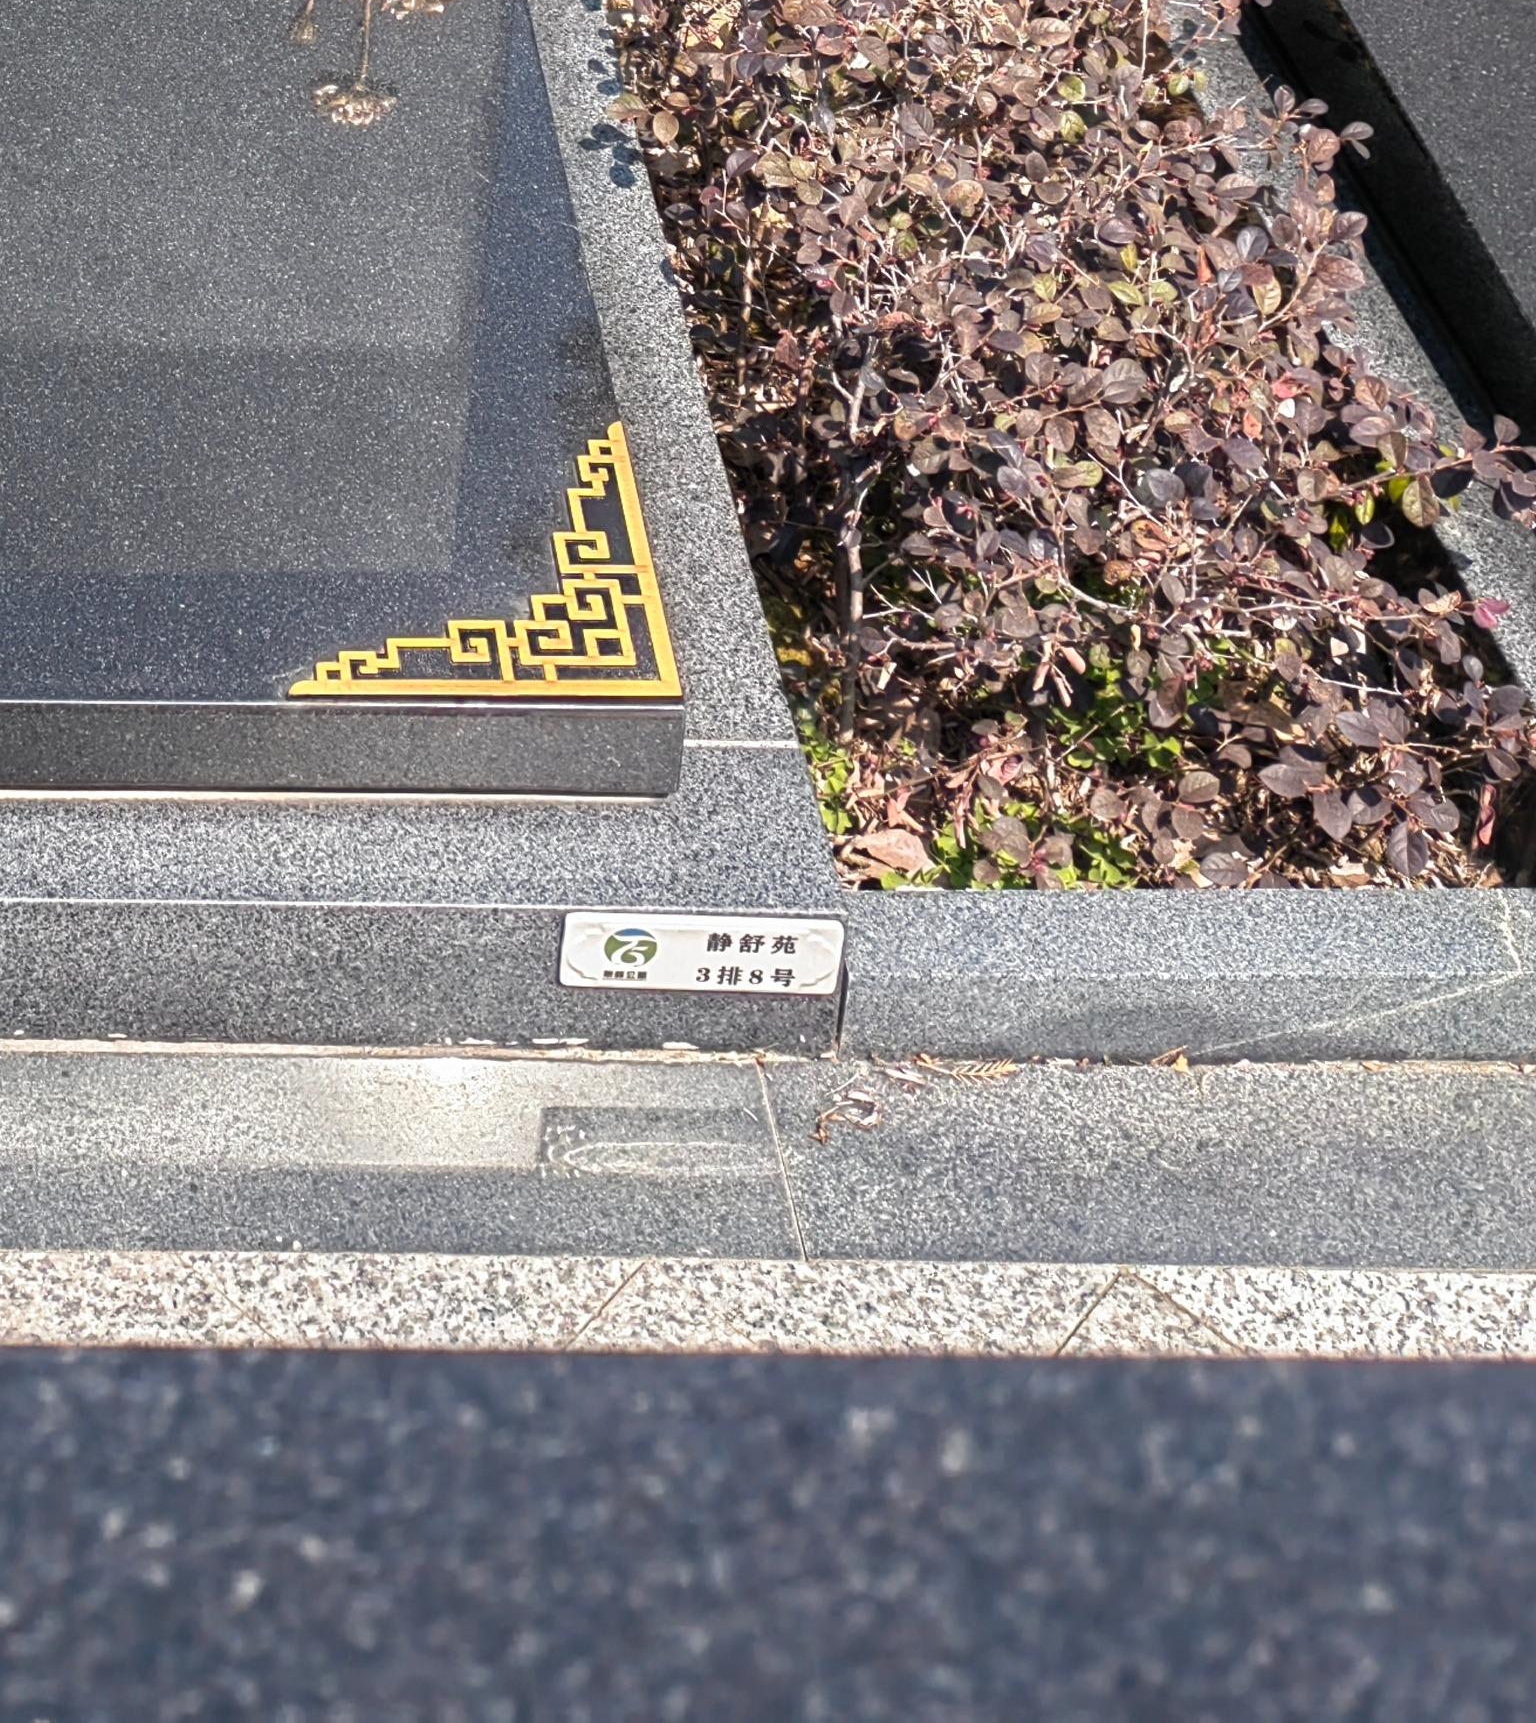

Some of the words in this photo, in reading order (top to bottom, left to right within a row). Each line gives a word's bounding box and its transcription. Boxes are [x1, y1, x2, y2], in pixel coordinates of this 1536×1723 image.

[706, 932, 799, 955] 静舒苑
[695, 966, 796, 987] 3排8号
